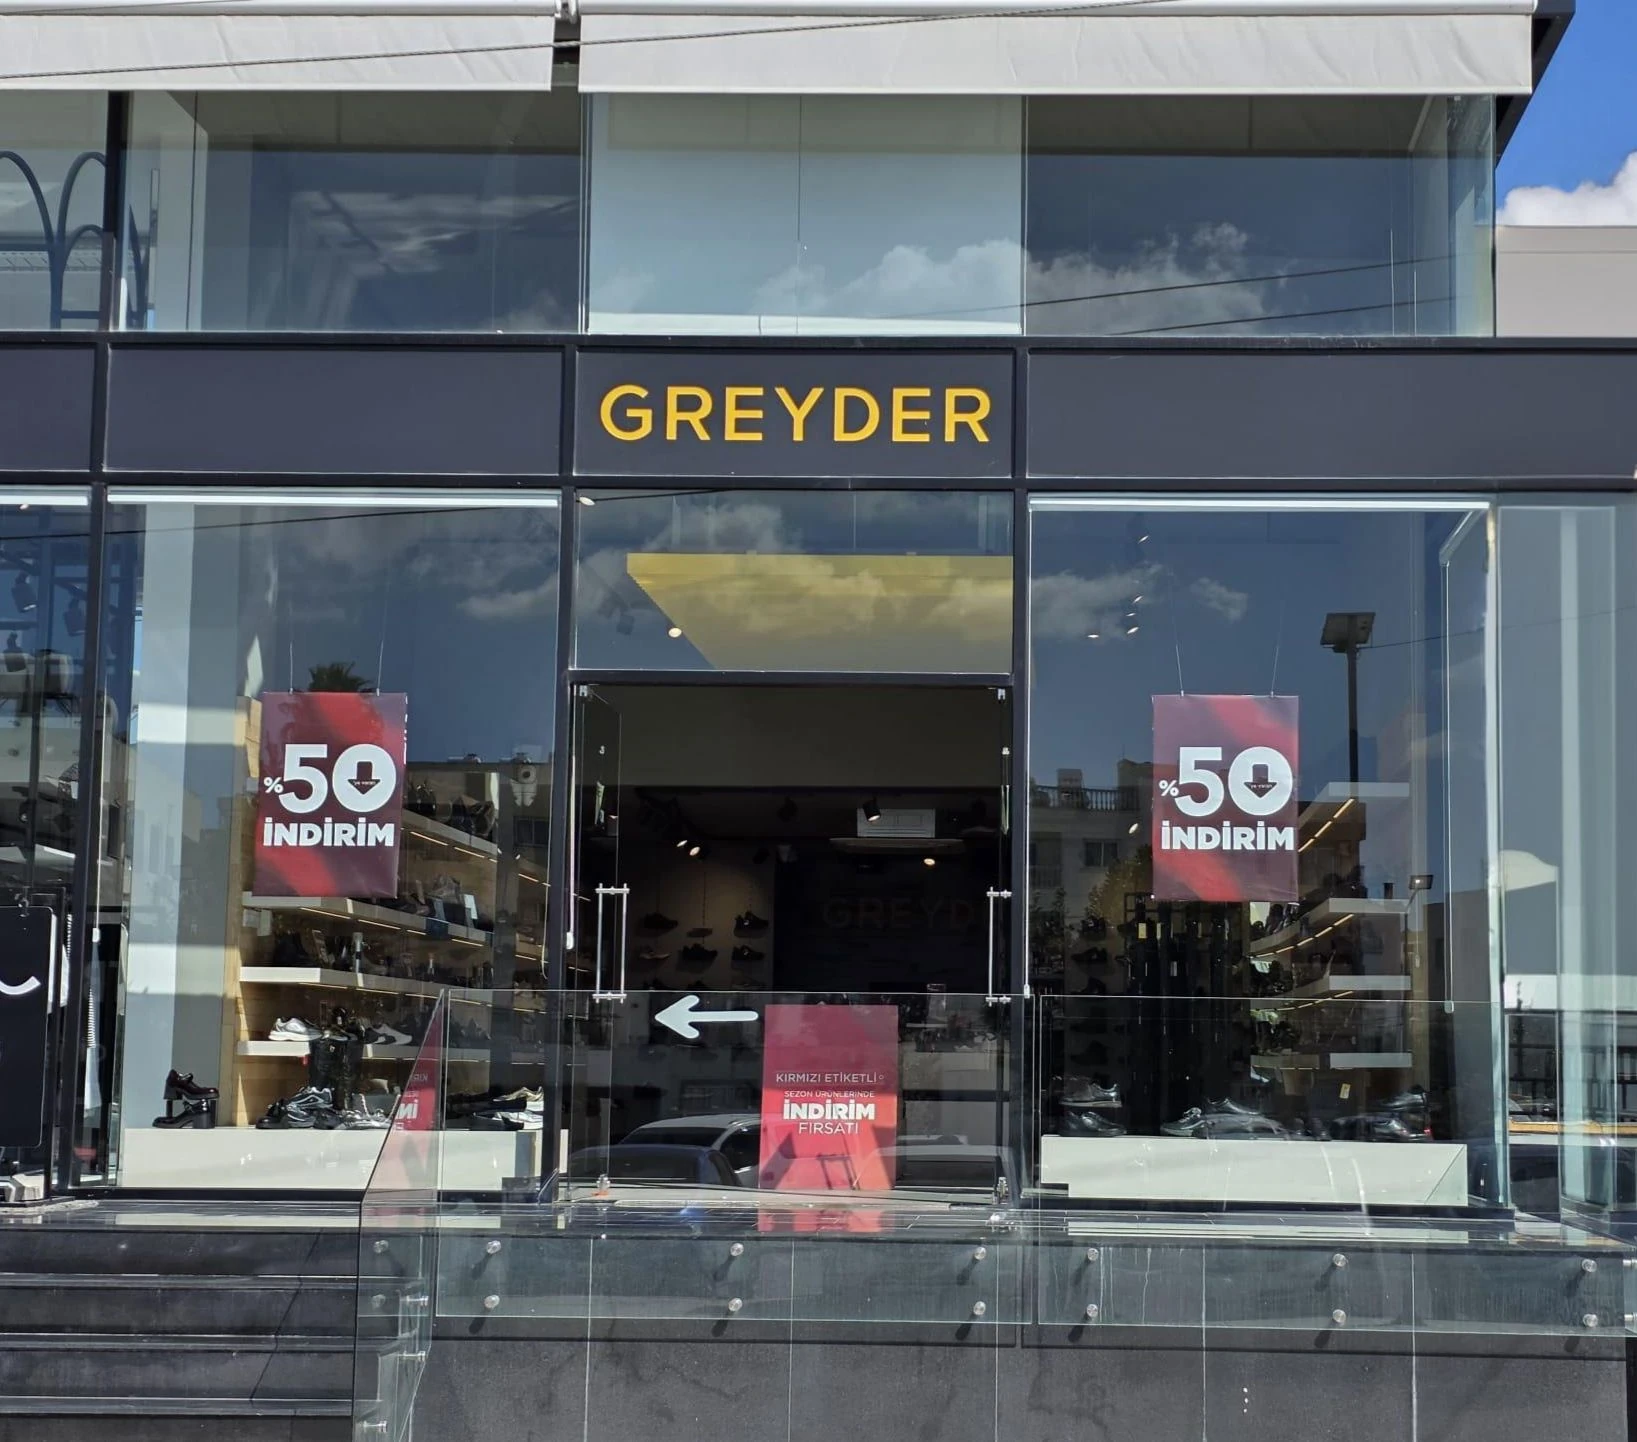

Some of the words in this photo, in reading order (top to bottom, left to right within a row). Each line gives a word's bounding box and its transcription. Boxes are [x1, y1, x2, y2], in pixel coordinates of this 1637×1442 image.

[600, 384, 990, 442] GREYDER
[263, 817, 395, 847] İNDİRİM
[1161, 820, 1294, 850] İNDİRİM
[776, 1073, 821, 1083] KIRMIZI
[783, 1099, 875, 1120] İNDİRİM
[798, 1122, 859, 1135] FIRSATI
